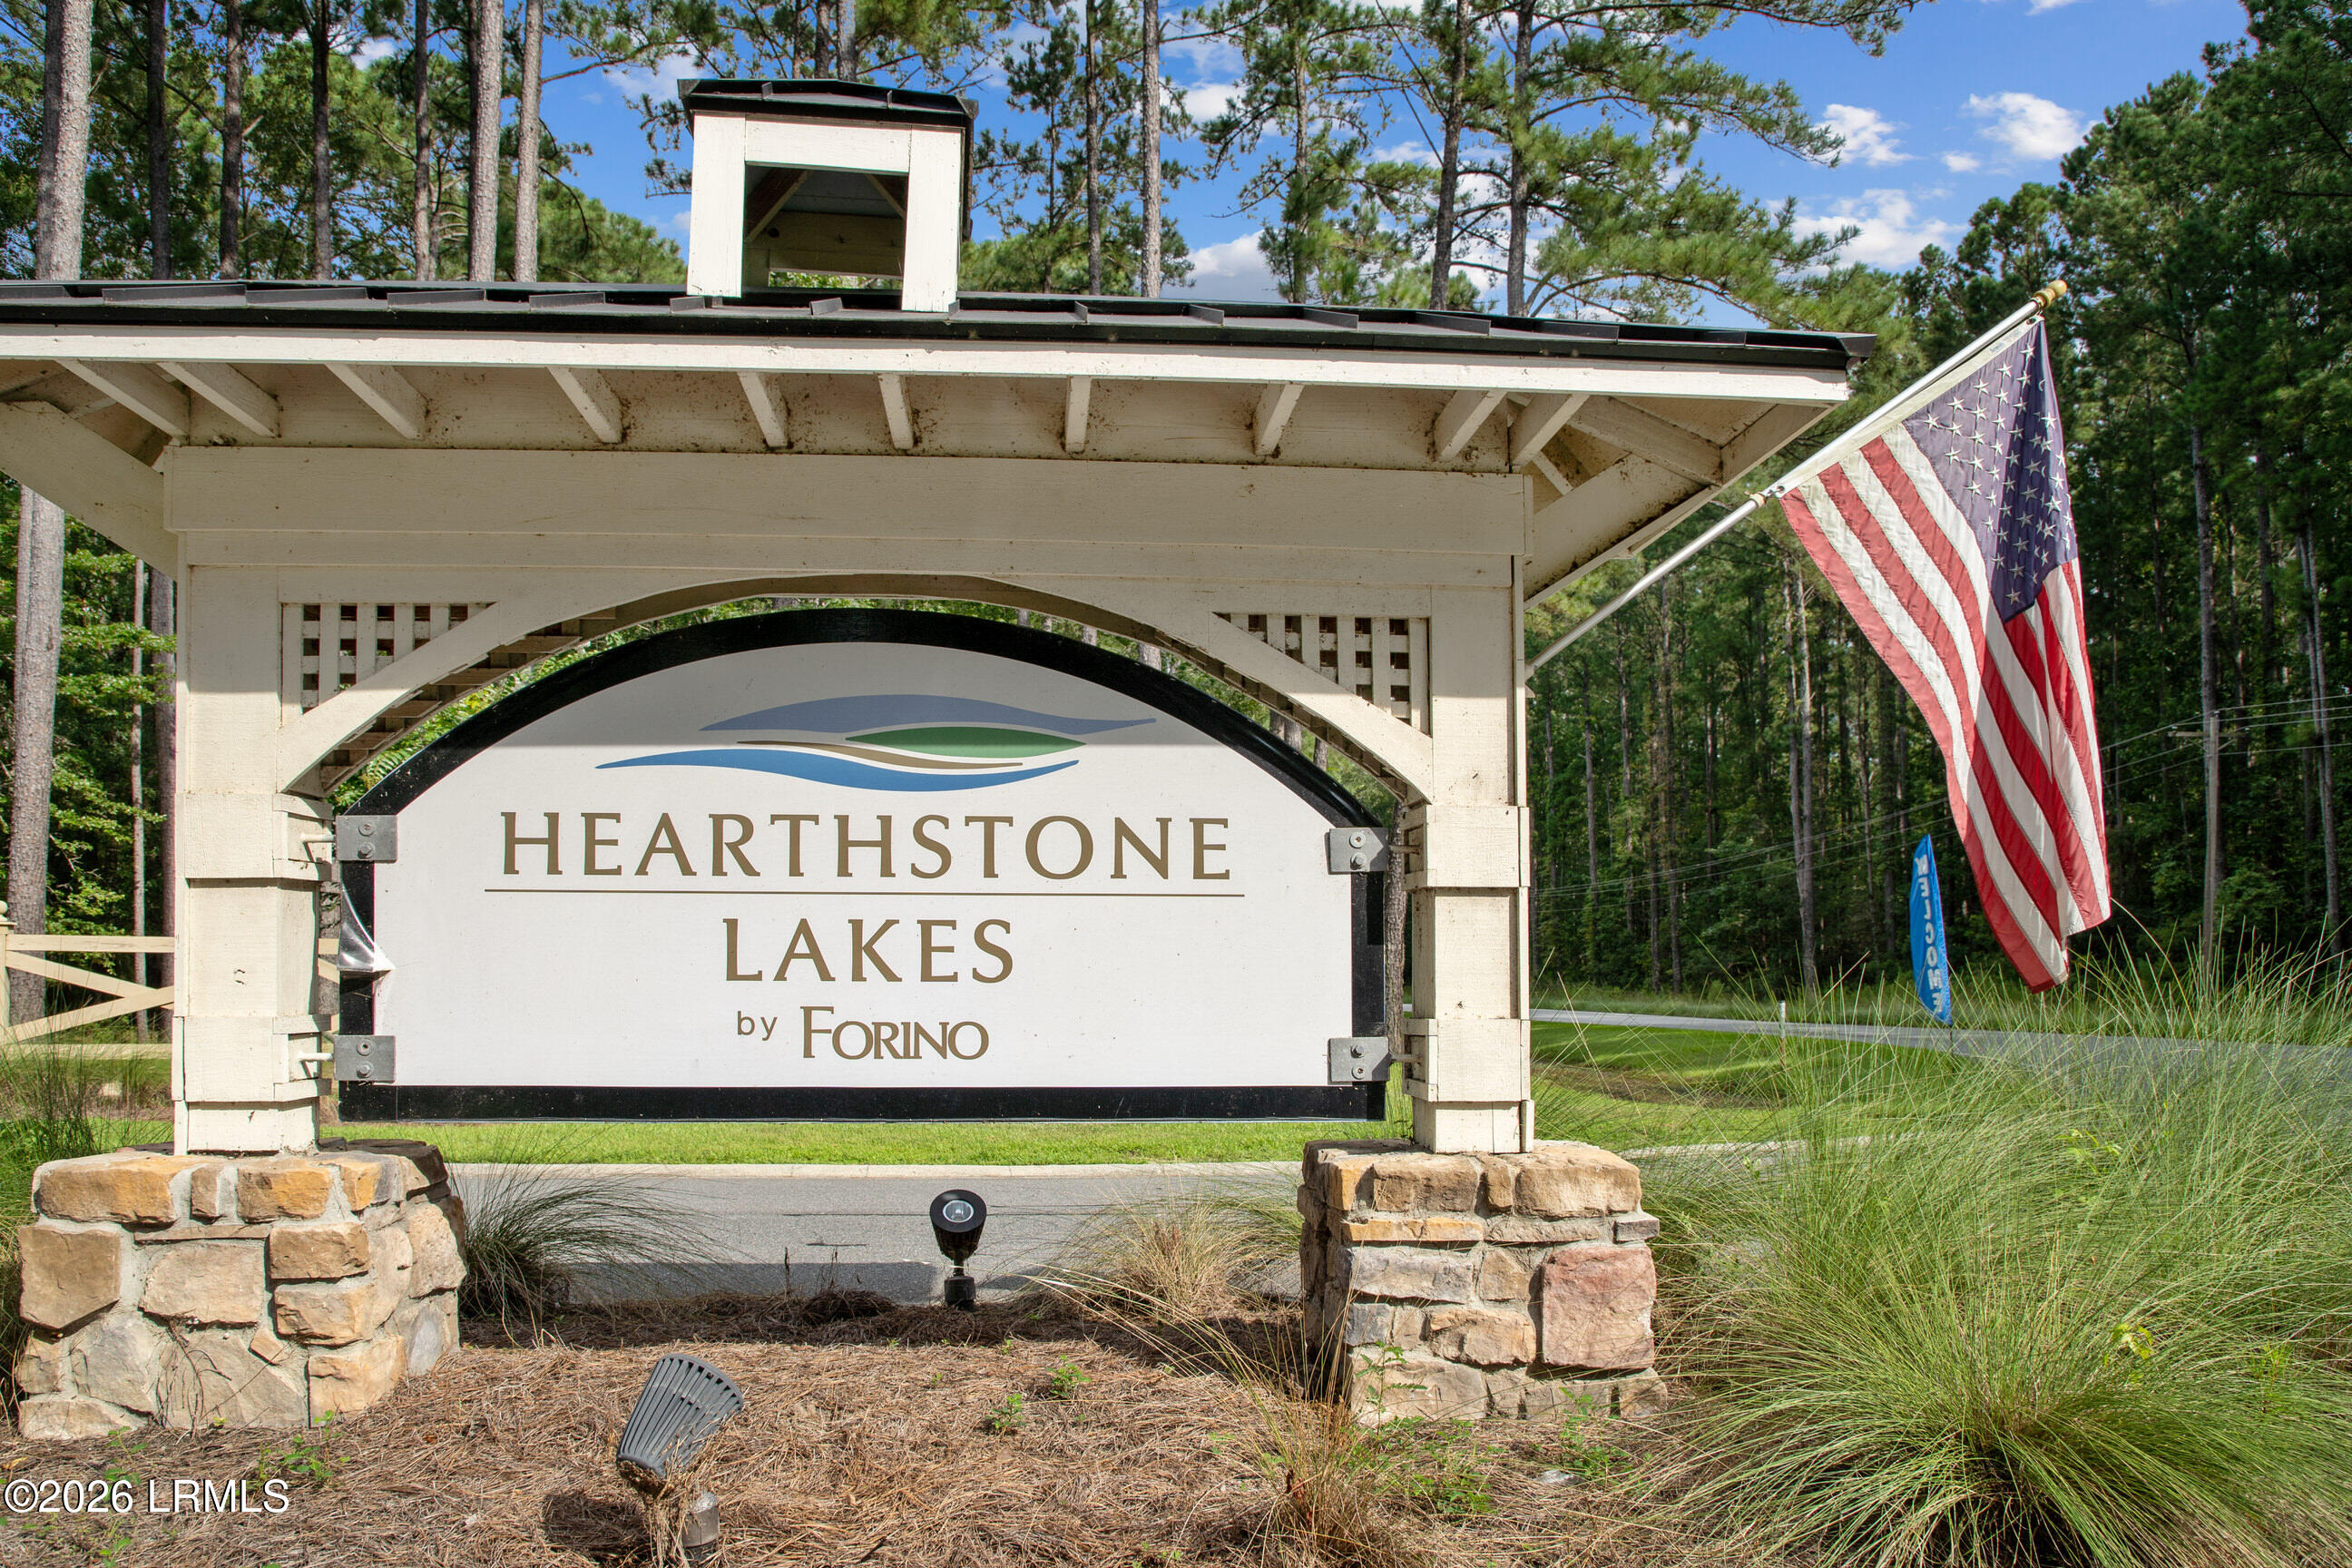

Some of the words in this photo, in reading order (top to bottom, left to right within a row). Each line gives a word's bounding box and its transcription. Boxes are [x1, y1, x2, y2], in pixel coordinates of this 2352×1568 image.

[500, 811, 1230, 880] HEARTHSTONE
[722, 917, 1014, 984] LAKES
[737, 1010, 779, 1042] by
[799, 1005, 989, 1061] FORINO
